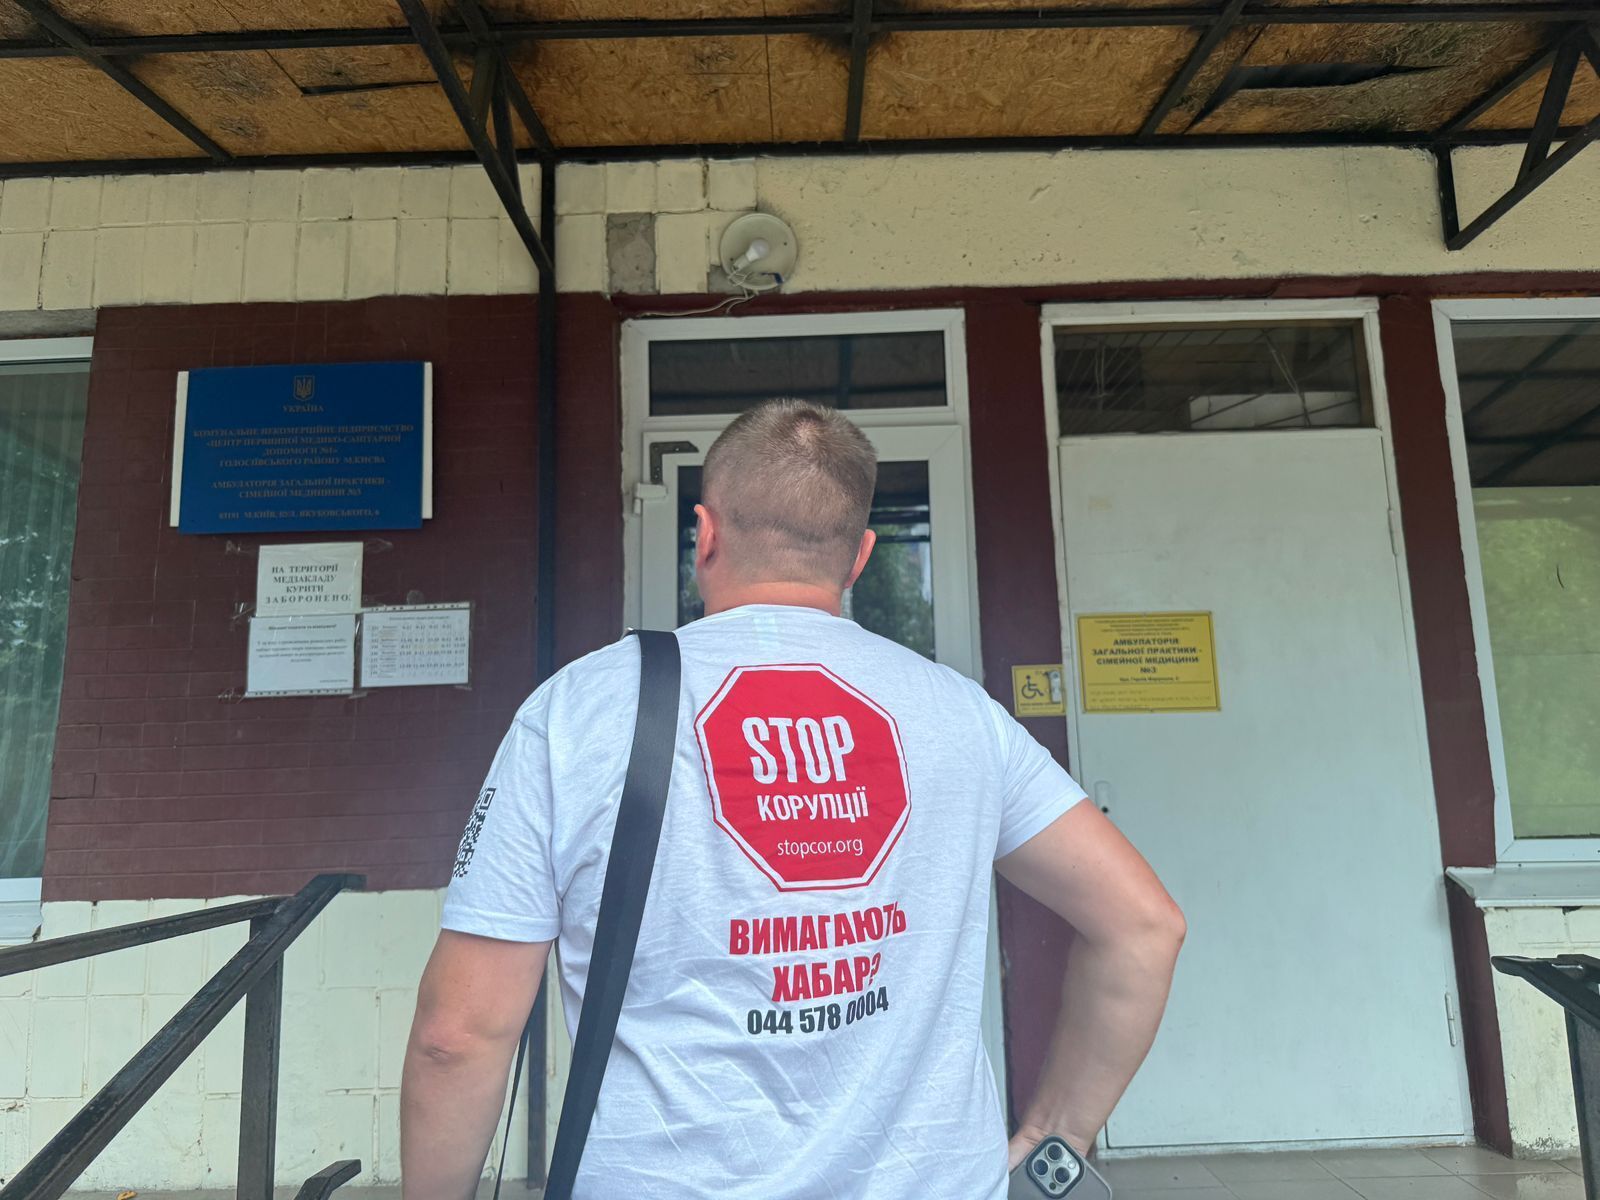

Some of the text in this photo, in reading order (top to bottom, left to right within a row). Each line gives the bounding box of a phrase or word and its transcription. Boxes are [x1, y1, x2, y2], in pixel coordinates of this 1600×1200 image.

[282, 403, 325, 413] УКРАЇНА
[271, 563, 339, 574] НА ТЕРИТОРІЇ
[273, 574, 337, 584] МЕДЗАКЛАДУ
[286, 585, 324, 593] КУРИТИ
[1112, 637, 1179, 646] АМБУЛАТОРІЯ
[1091, 647, 1145, 656] ЗАГАЛЬНОЇ
[1146, 646, 1197, 655] ПРАКТИКИ
[1096, 656, 1199, 665] СІМЕЙНОЇ МЕДИЦИНИ
[741, 715, 855, 784] STOP
[756, 786, 869, 823] КОРУПЦІЇ
[776, 838, 864, 858] stopcor.org
[729, 901, 907, 954] ВИМАГАЮТЬ
[772, 952, 882, 1002] ХАБАР?
[747, 986, 889, 1035] 044 578 0004
